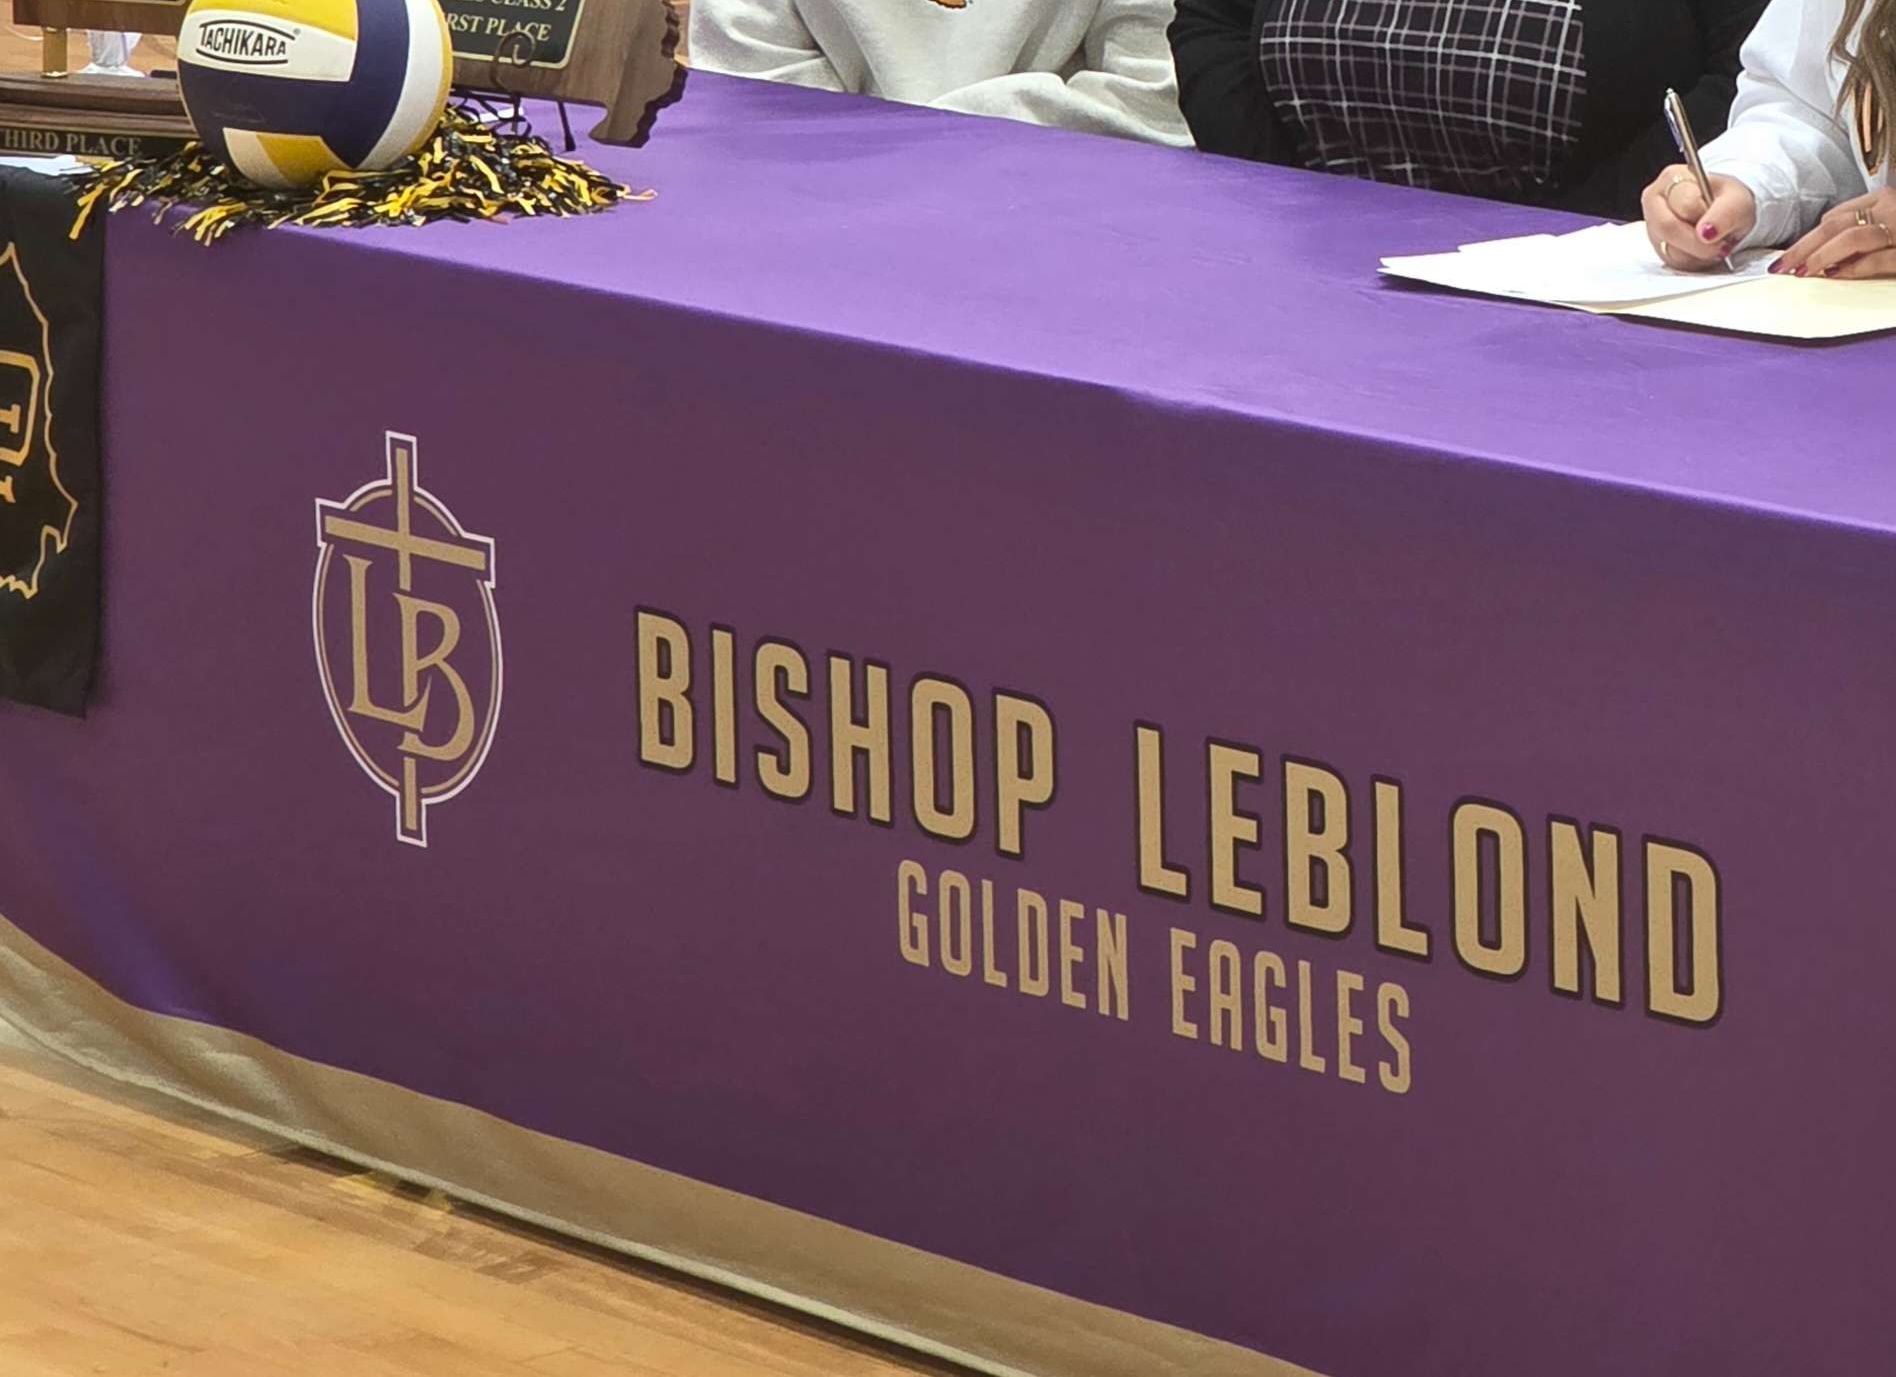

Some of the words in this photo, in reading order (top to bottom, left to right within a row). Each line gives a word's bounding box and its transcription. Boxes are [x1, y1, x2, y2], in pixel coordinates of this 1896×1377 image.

[199, 25, 287, 57] TACHIKARA
[447, 13, 483, 34] RST
[485, 16, 551, 41] PLACE
[0, 129, 60, 150] HIRD
[66, 134, 142, 155] PLACE
[341, 553, 475, 760] LB
[637, 611, 1055, 855] BISHOP
[1136, 726, 1720, 1023] LEBLOND
[897, 860, 1129, 1021] GOLDEN
[1171, 926, 1411, 1093] EAGLES
